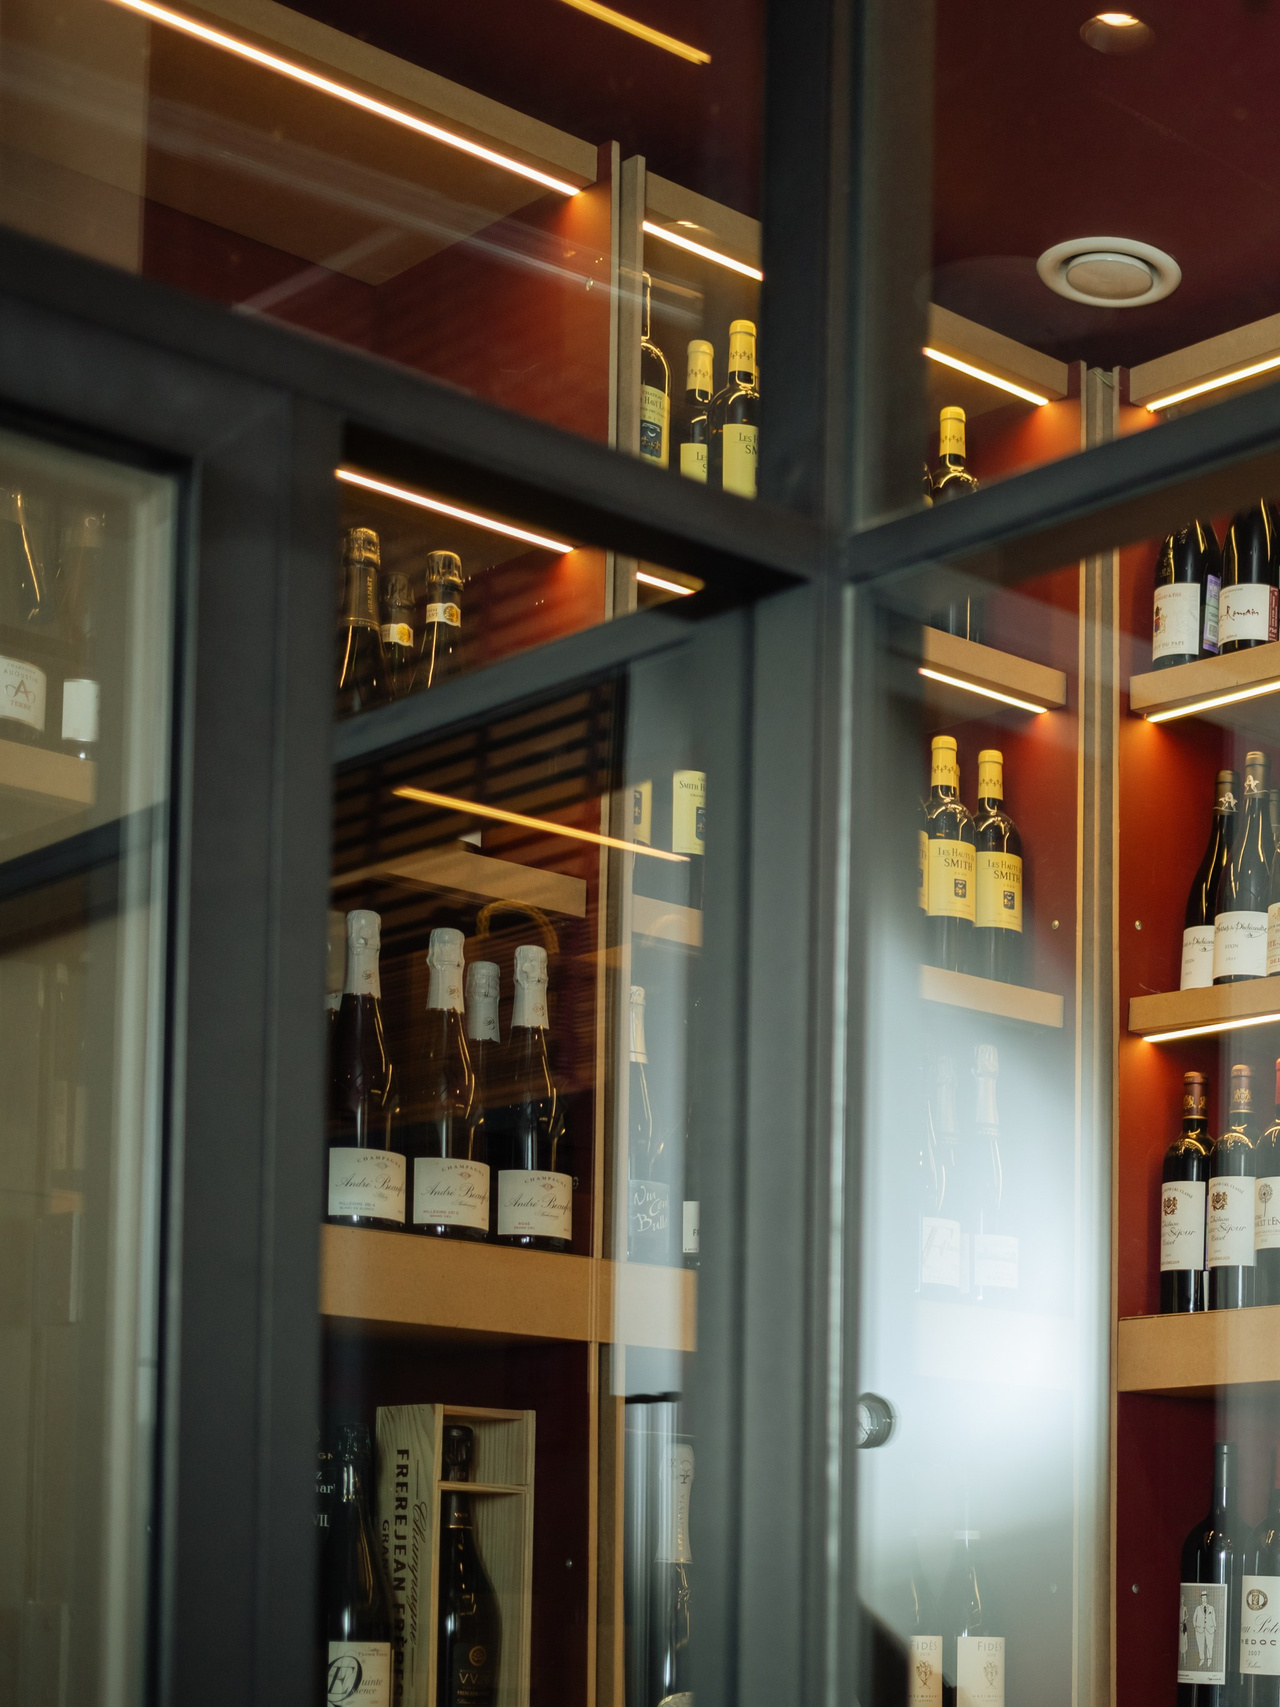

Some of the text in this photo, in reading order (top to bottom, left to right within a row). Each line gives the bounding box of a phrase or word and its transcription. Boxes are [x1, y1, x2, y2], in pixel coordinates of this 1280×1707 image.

[679, 780, 699, 791] SMITH
[938, 847, 970, 860] LES HAUTS
[944, 858, 973, 872] SMITH
[987, 859, 1000, 869] LES
[993, 870, 1021, 883] SMITH
[334, 1173, 371, 1189] André
[420, 1180, 457, 1197] André
[504, 1192, 541, 1208] André
[392, 1449, 409, 1592] FREREJEAN
